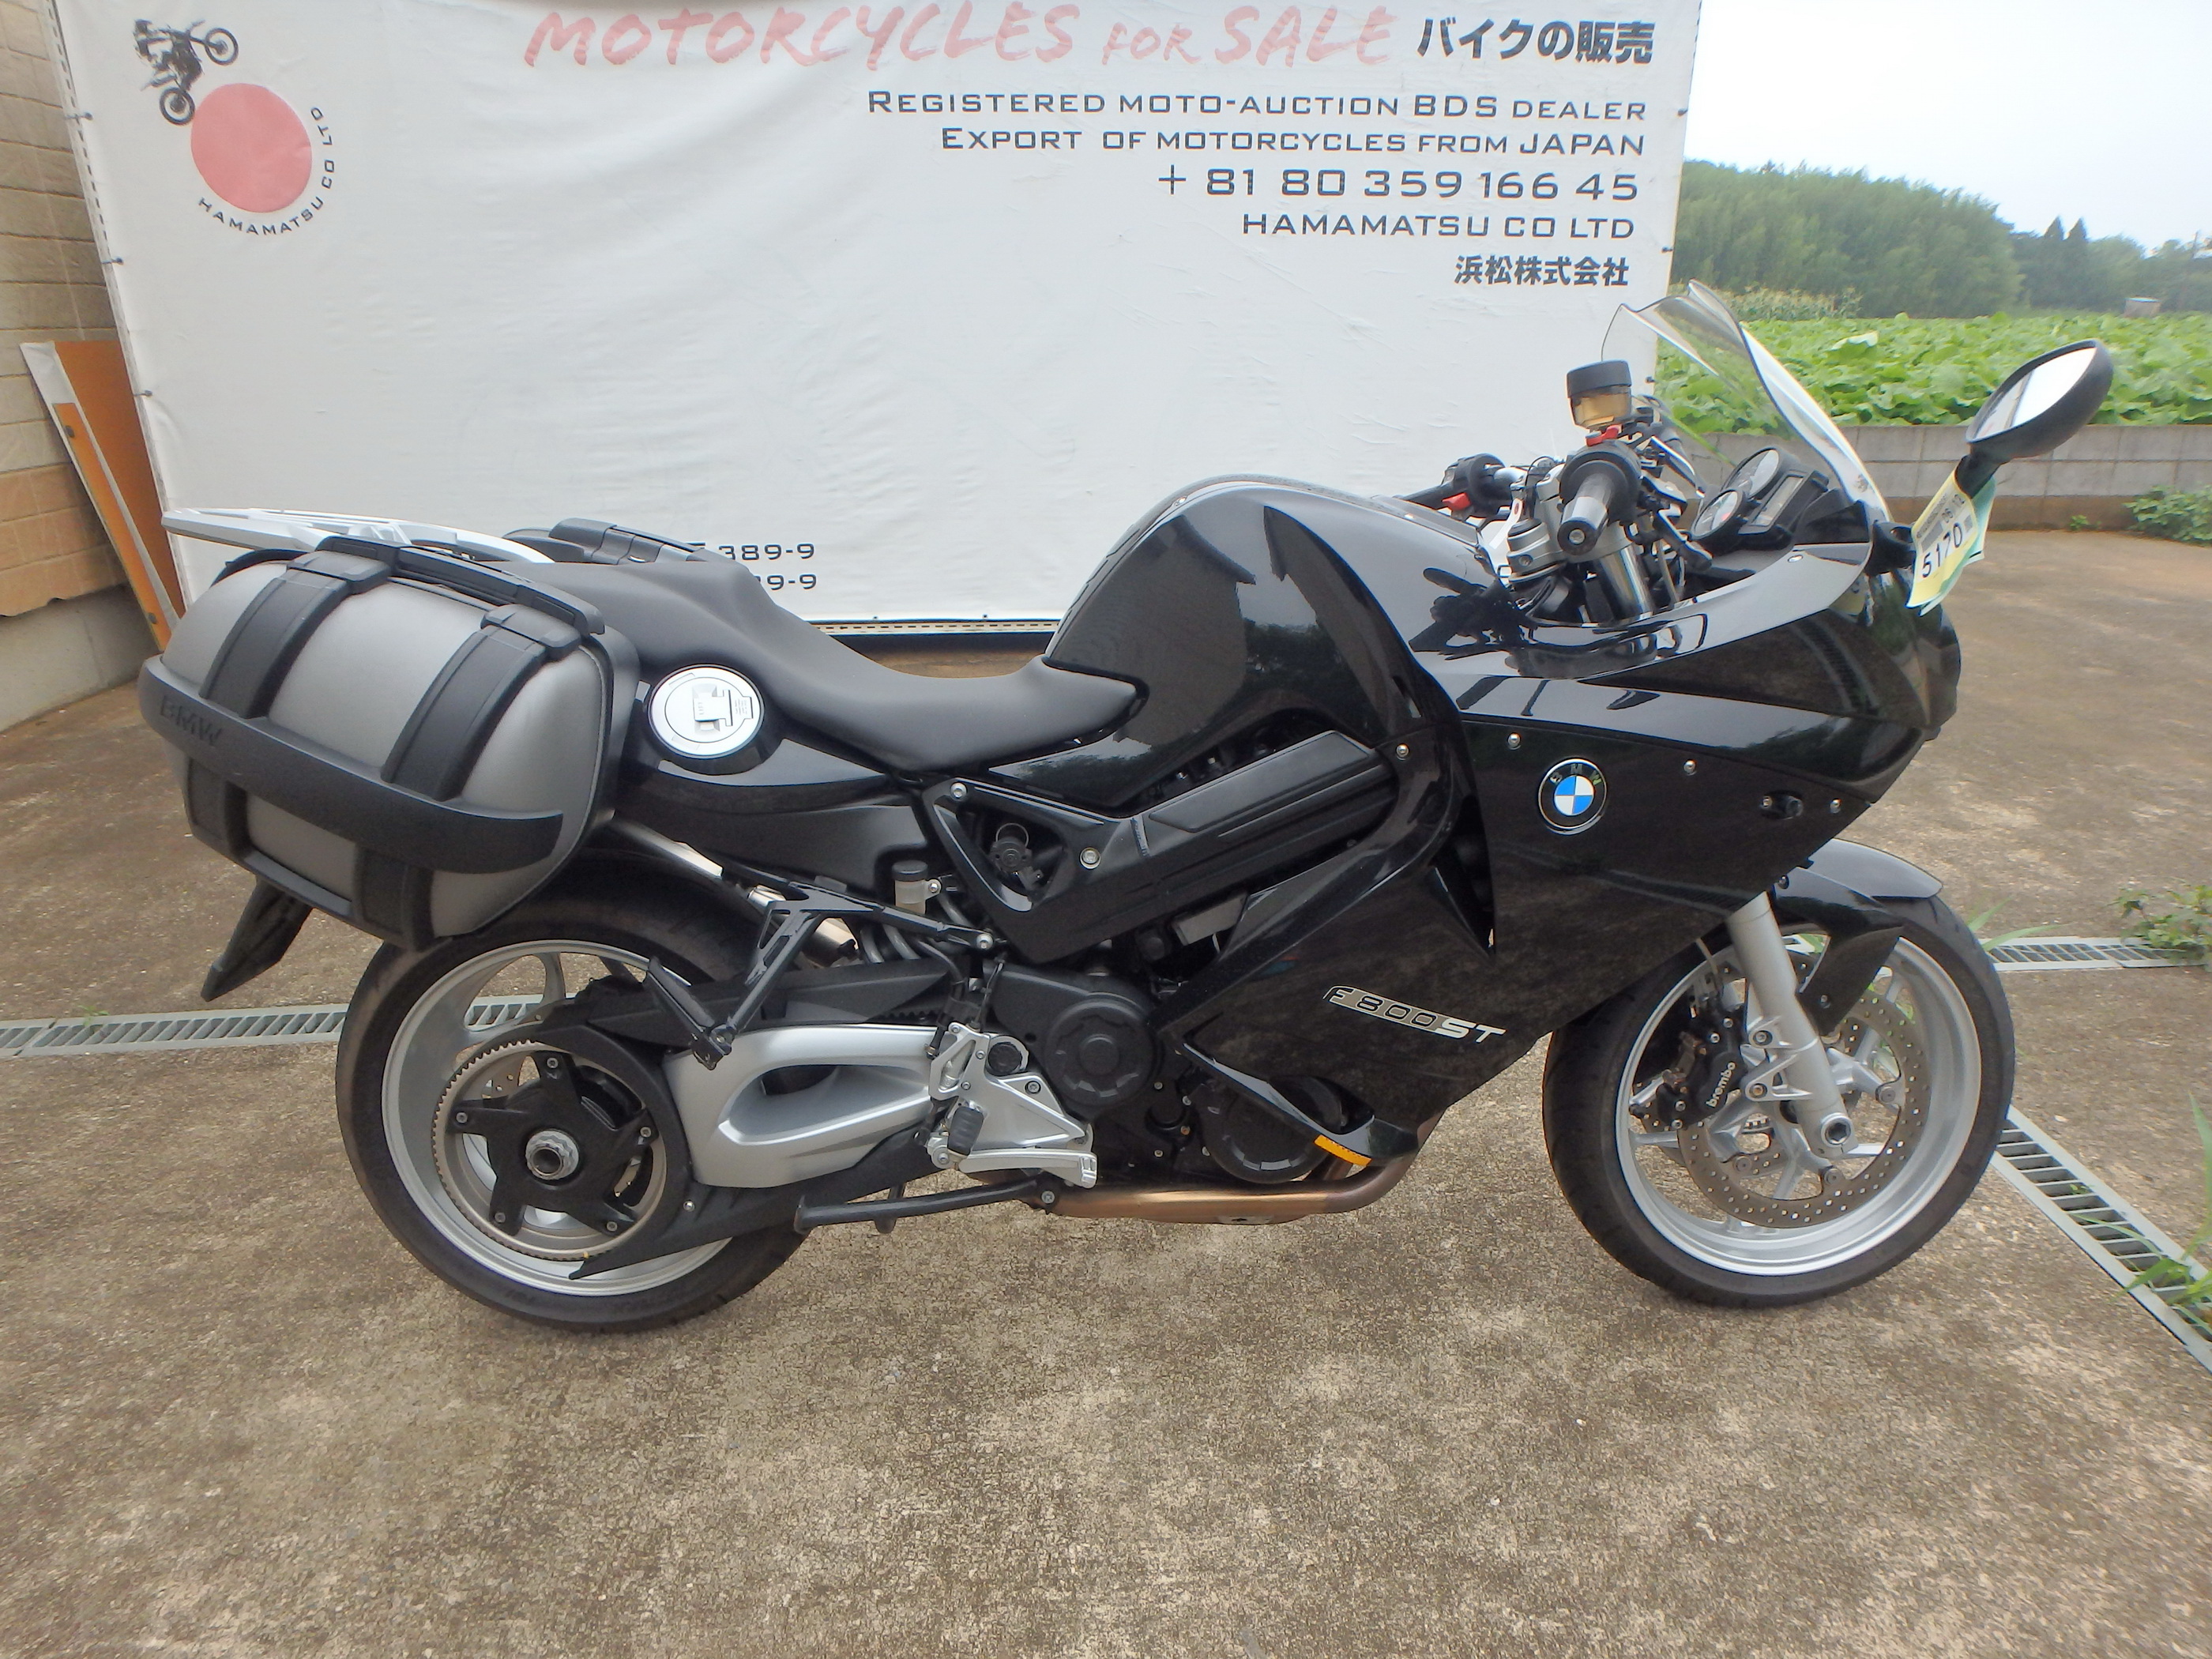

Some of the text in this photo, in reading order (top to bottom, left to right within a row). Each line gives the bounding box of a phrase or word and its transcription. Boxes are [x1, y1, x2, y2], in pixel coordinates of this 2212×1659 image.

[524, 1, 1080, 71] MOTORCYCLES
[1215, 6, 1398, 68] SALE
[1416, 17, 1656, 65] バイクの販売
[1119, 94, 1398, 116] MOTO-AUCTION
[1414, 95, 1498, 118] BDS
[1512, 100, 1646, 121] DEALER
[942, 128, 1645, 156] EXPORT OF MOTORCYCLES FROM JAPAN
[198, 107, 334, 235] HAMAMATSU CO LTD
[1206, 169, 1255, 196] 81
[1281, 169, 1345, 197] 80
[1575, 174, 1638, 201] 45
[1243, 213, 1635, 239] HAMAMATSU CO LTD
[1454, 255, 1630, 287] 浜松株式会社
[1921, 522, 1963, 578] 5170
[160, 694, 223, 746] BMW
[1549, 763, 1602, 785] BMW
[1705, 1061, 1737, 1108] brembo
